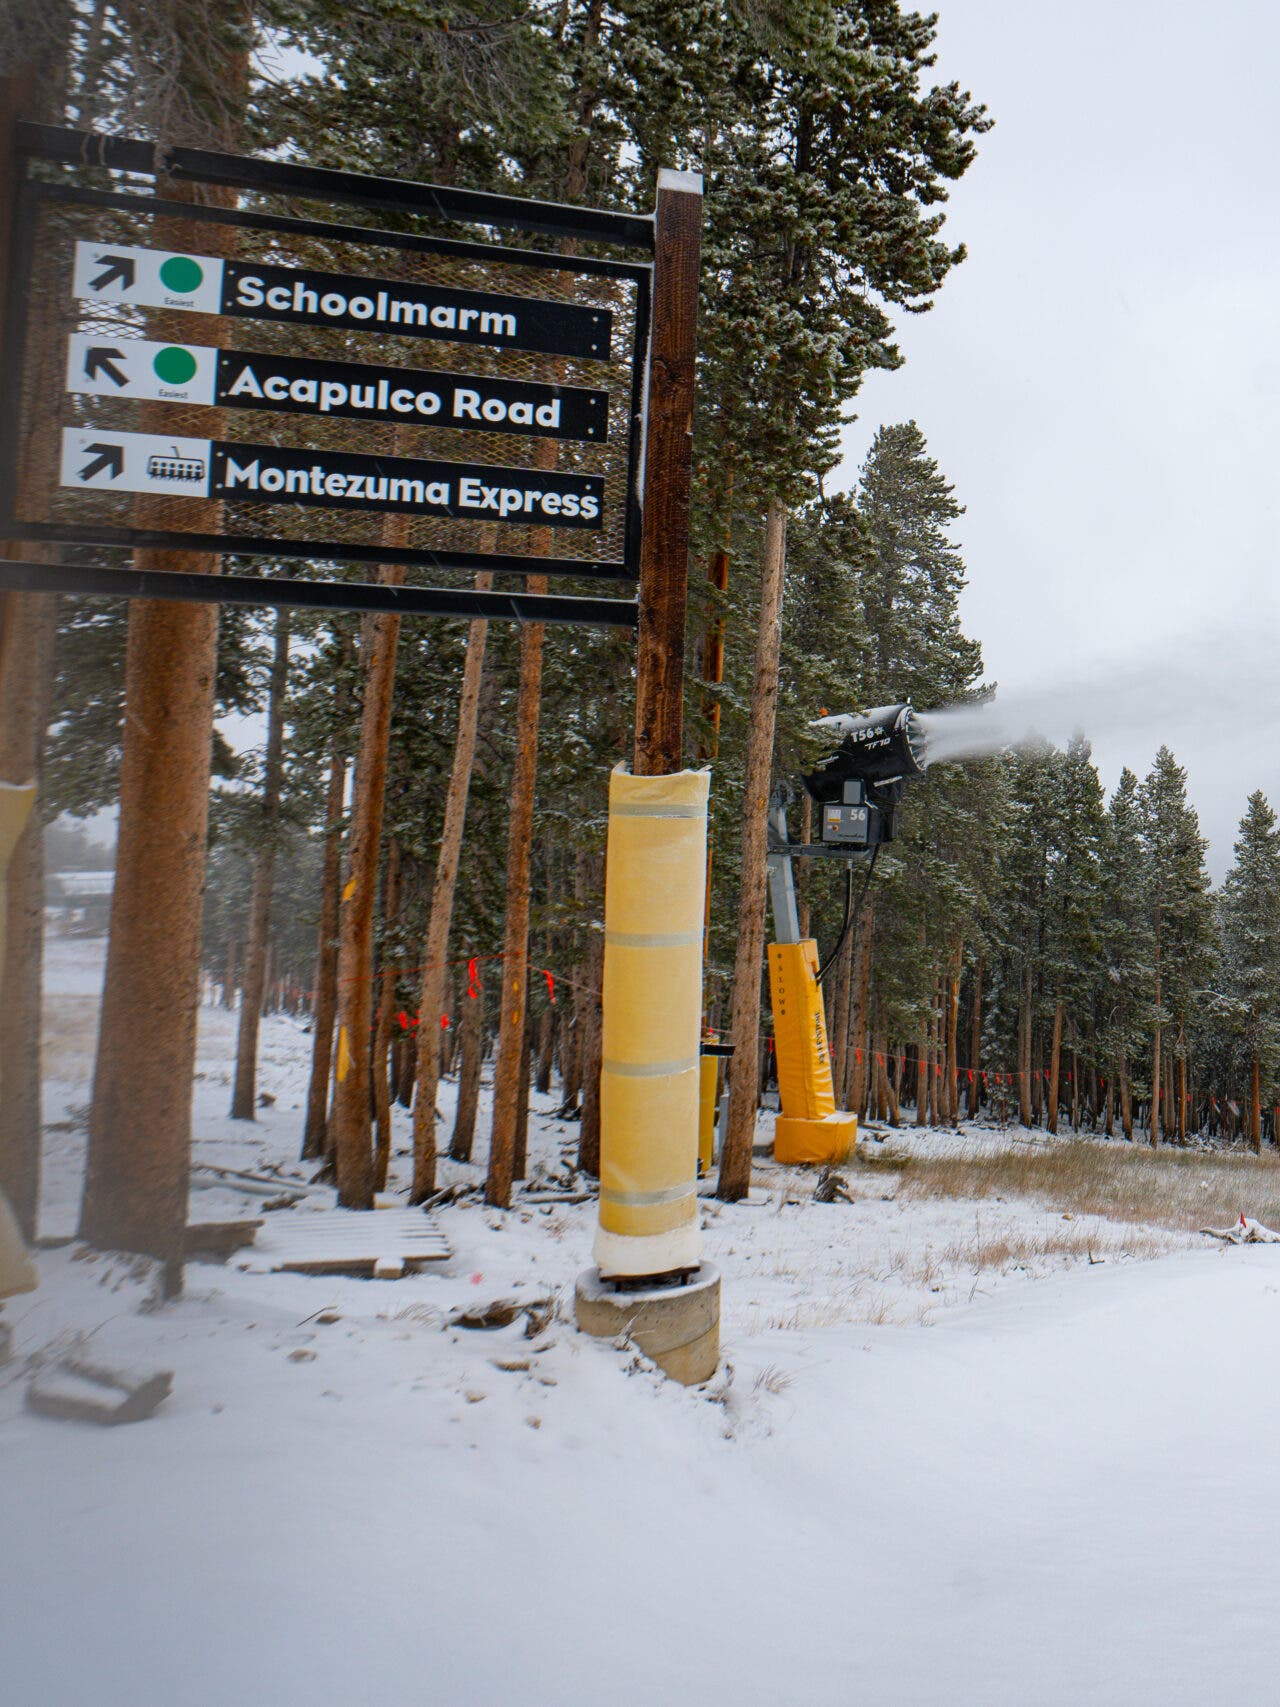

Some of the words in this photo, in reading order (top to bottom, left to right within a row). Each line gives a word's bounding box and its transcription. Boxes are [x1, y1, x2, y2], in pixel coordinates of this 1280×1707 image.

[164, 297, 195, 307] Easiest
[236, 276, 517, 337] Schoolmarm
[158, 389, 189, 399] Easiest
[228, 365, 442, 415] Acapulco
[452, 387, 561, 428] Road
[225, 457, 451, 505] Montezuma
[458, 477, 599, 519] Express
[850, 728, 875, 743] T56
[850, 809, 866, 821] 56
